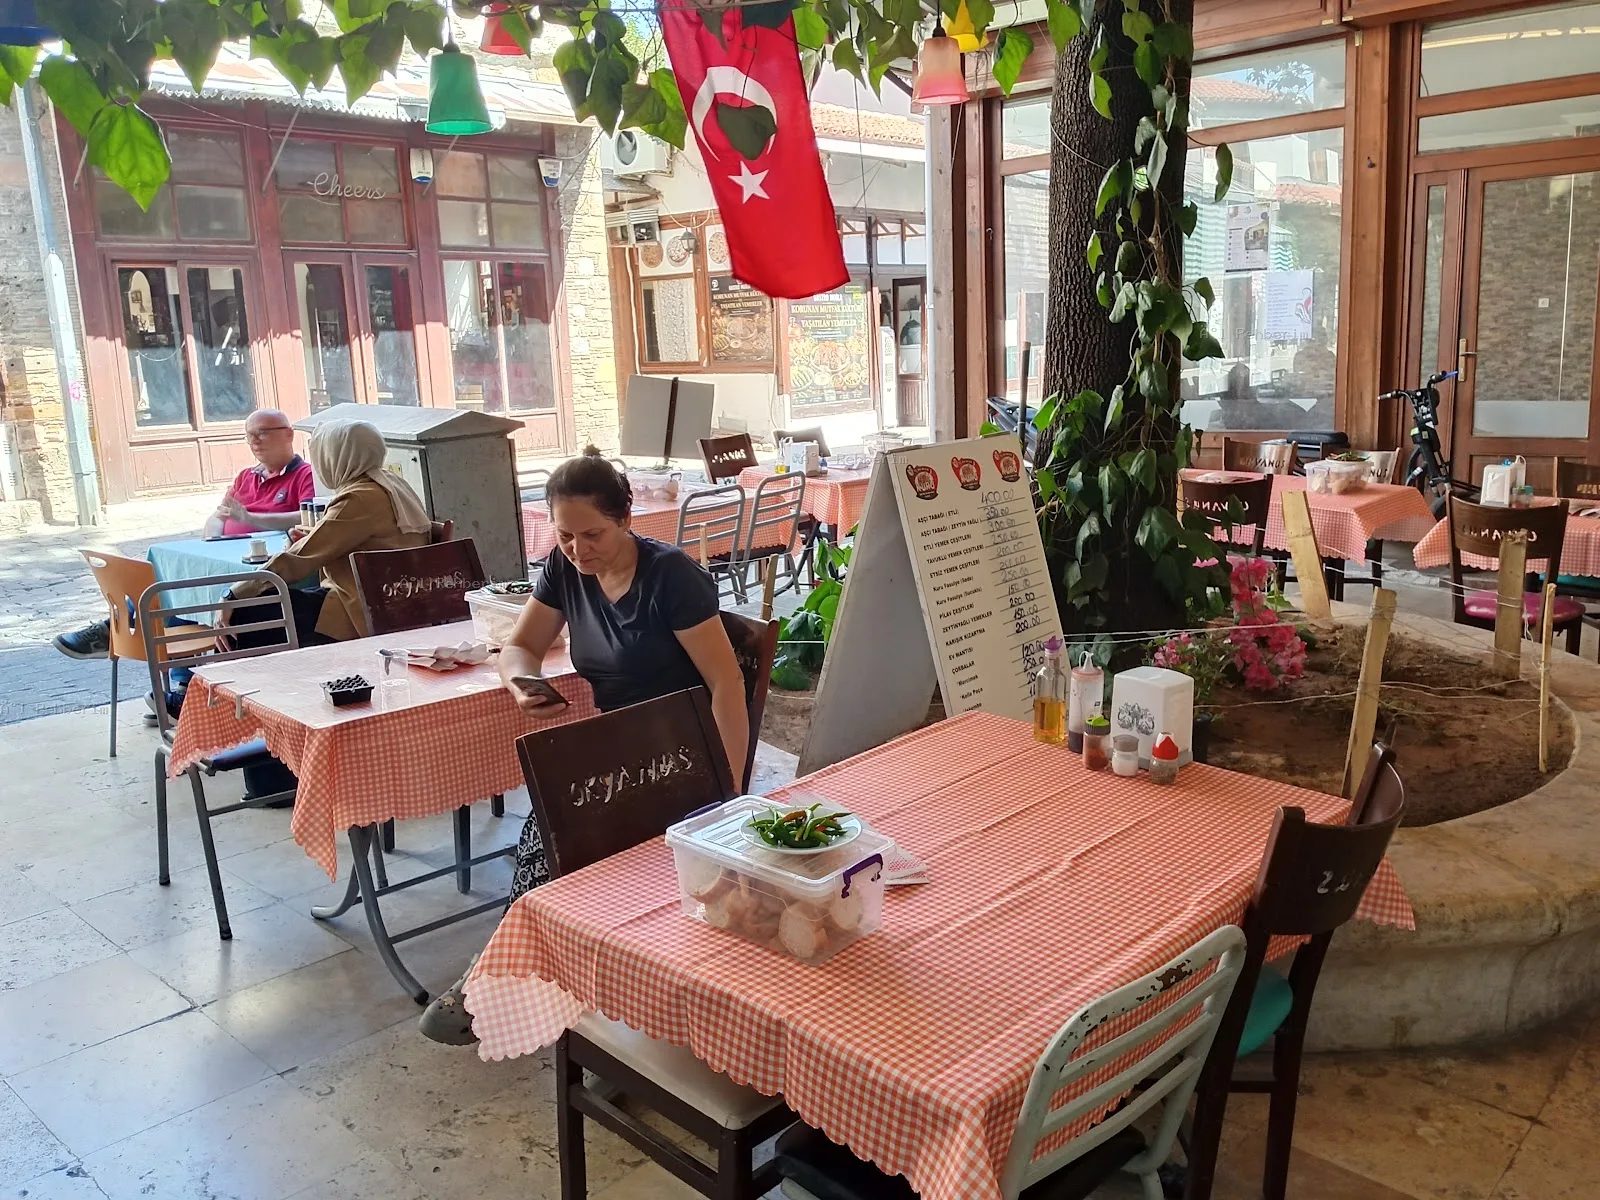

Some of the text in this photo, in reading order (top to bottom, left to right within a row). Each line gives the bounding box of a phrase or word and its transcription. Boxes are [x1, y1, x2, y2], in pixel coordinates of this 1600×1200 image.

[306, 172, 386, 199] Cheers
[791, 305, 820, 313] KORUNAN
[819, 304, 841, 313] MUTFAK
[934, 539, 949, 549] YEMEK
[947, 551, 962, 560] YEMEK
[943, 566, 958, 575] YEMEK
[944, 580, 960, 589] Fasulye
[947, 593, 963, 603] Fasulye
[939, 611, 952, 619] PİLAV
[971, 610, 993, 622] YEMEKLER
